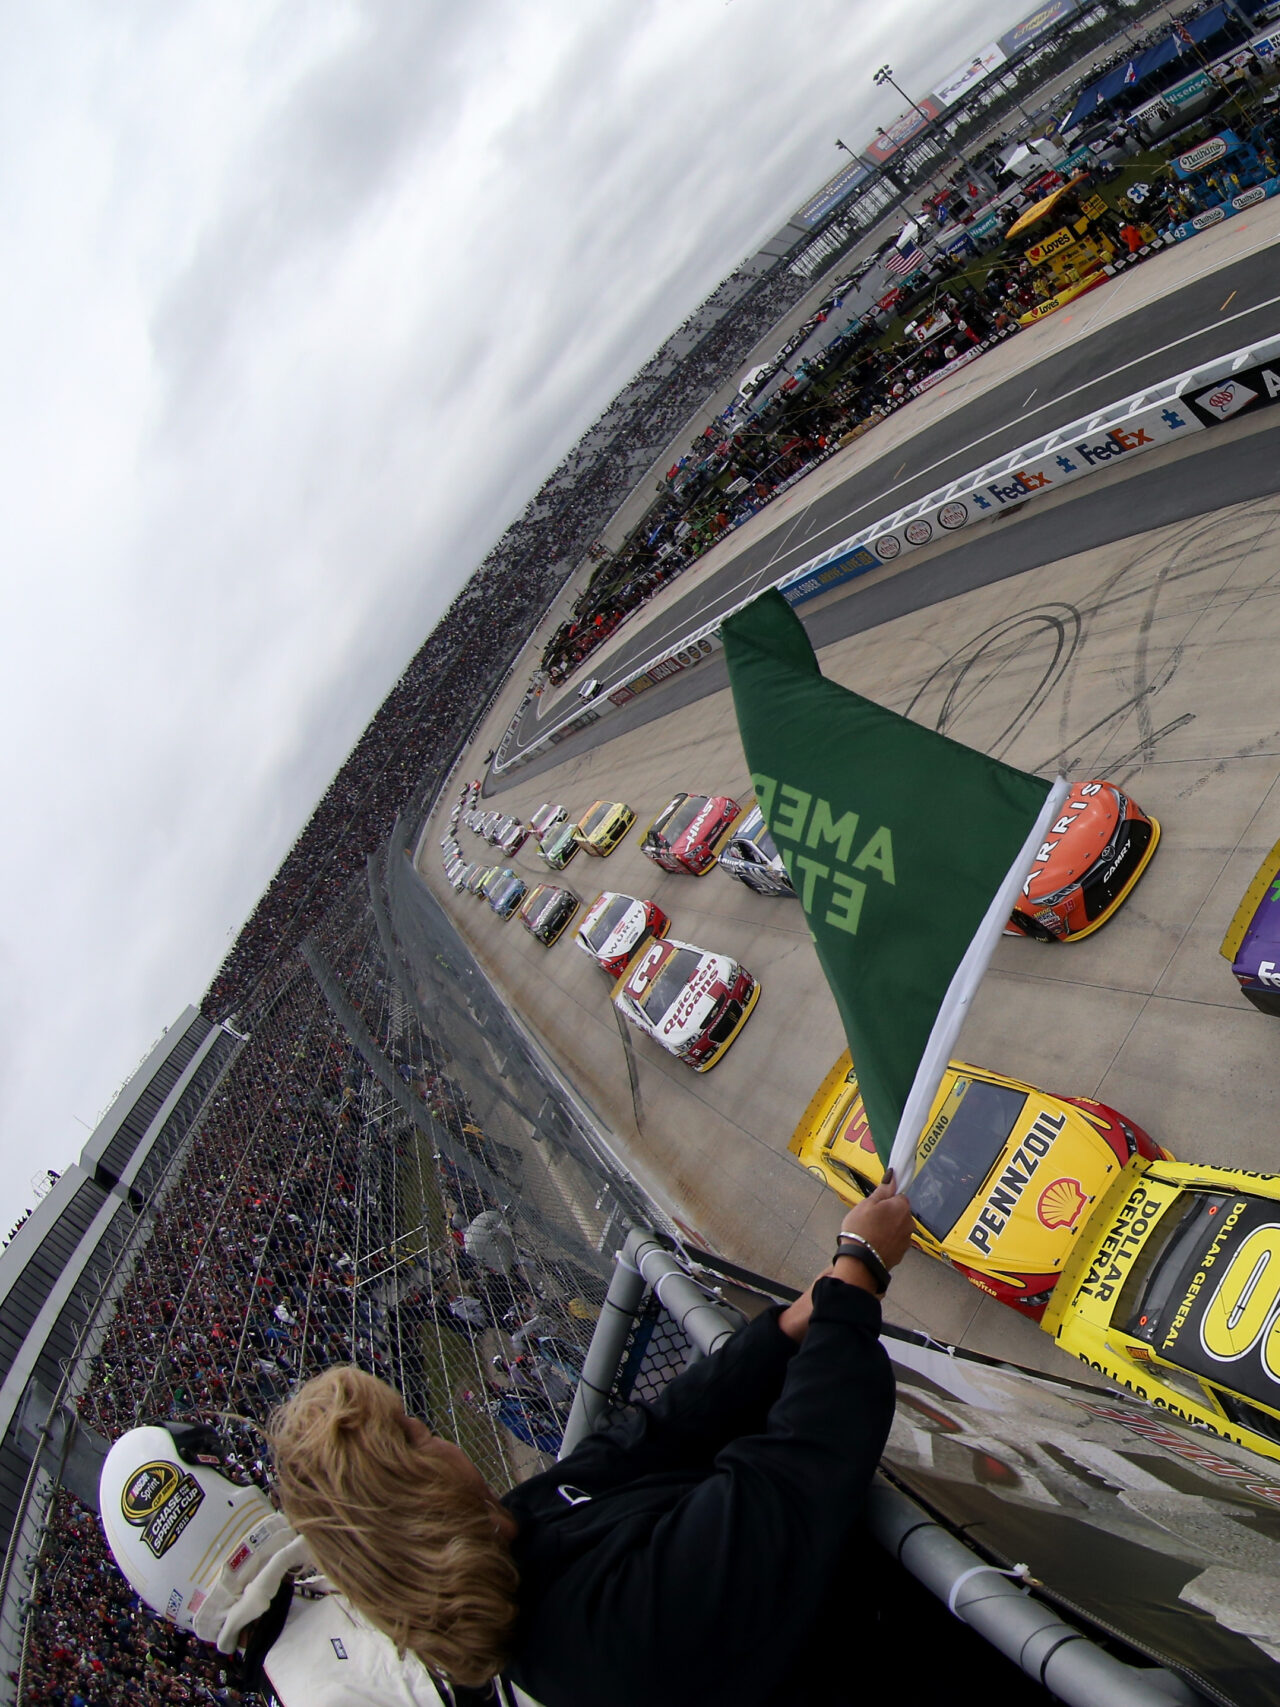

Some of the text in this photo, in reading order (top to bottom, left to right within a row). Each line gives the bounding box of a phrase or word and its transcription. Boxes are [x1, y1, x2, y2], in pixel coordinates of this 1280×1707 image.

[941, 54, 996, 99] FedEx
[1165, 77, 1210, 103] Hisense
[1181, 141, 1227, 168] Nathan's
[1173, 226, 1187, 239] 43
[916, 329, 926, 341] 5
[1209, 389, 1233, 408] AAA
[1076, 427, 1154, 466] FedEx
[987, 471, 1053, 504] FedEx
[1103, 838, 1133, 884] CAMRY
[1065, 900, 1075, 912] 19
[664, 958, 717, 1035] Quicken
[677, 969, 719, 1030] Loans
[919, 1115, 950, 1160] LOGANO
[967, 1111, 1066, 1260] PENNZOIL
[1083, 1187, 1148, 1300] GENERAL
[1095, 1201, 1161, 1303] DOLLAR
[1162, 1201, 1248, 1351] DOLLAR GENERAL
[1078, 1351, 1148, 1401] DOLLAR
[1066, 1397, 1263, 1482] MILE
[134, 1472, 150, 1498] NASCAR
[140, 1478, 160, 1502] Sprint
[152, 1493, 181, 1536] CHASE
[154, 1487, 199, 1550] SPRINT CUP
[175, 1516, 190, 1536] 2015
